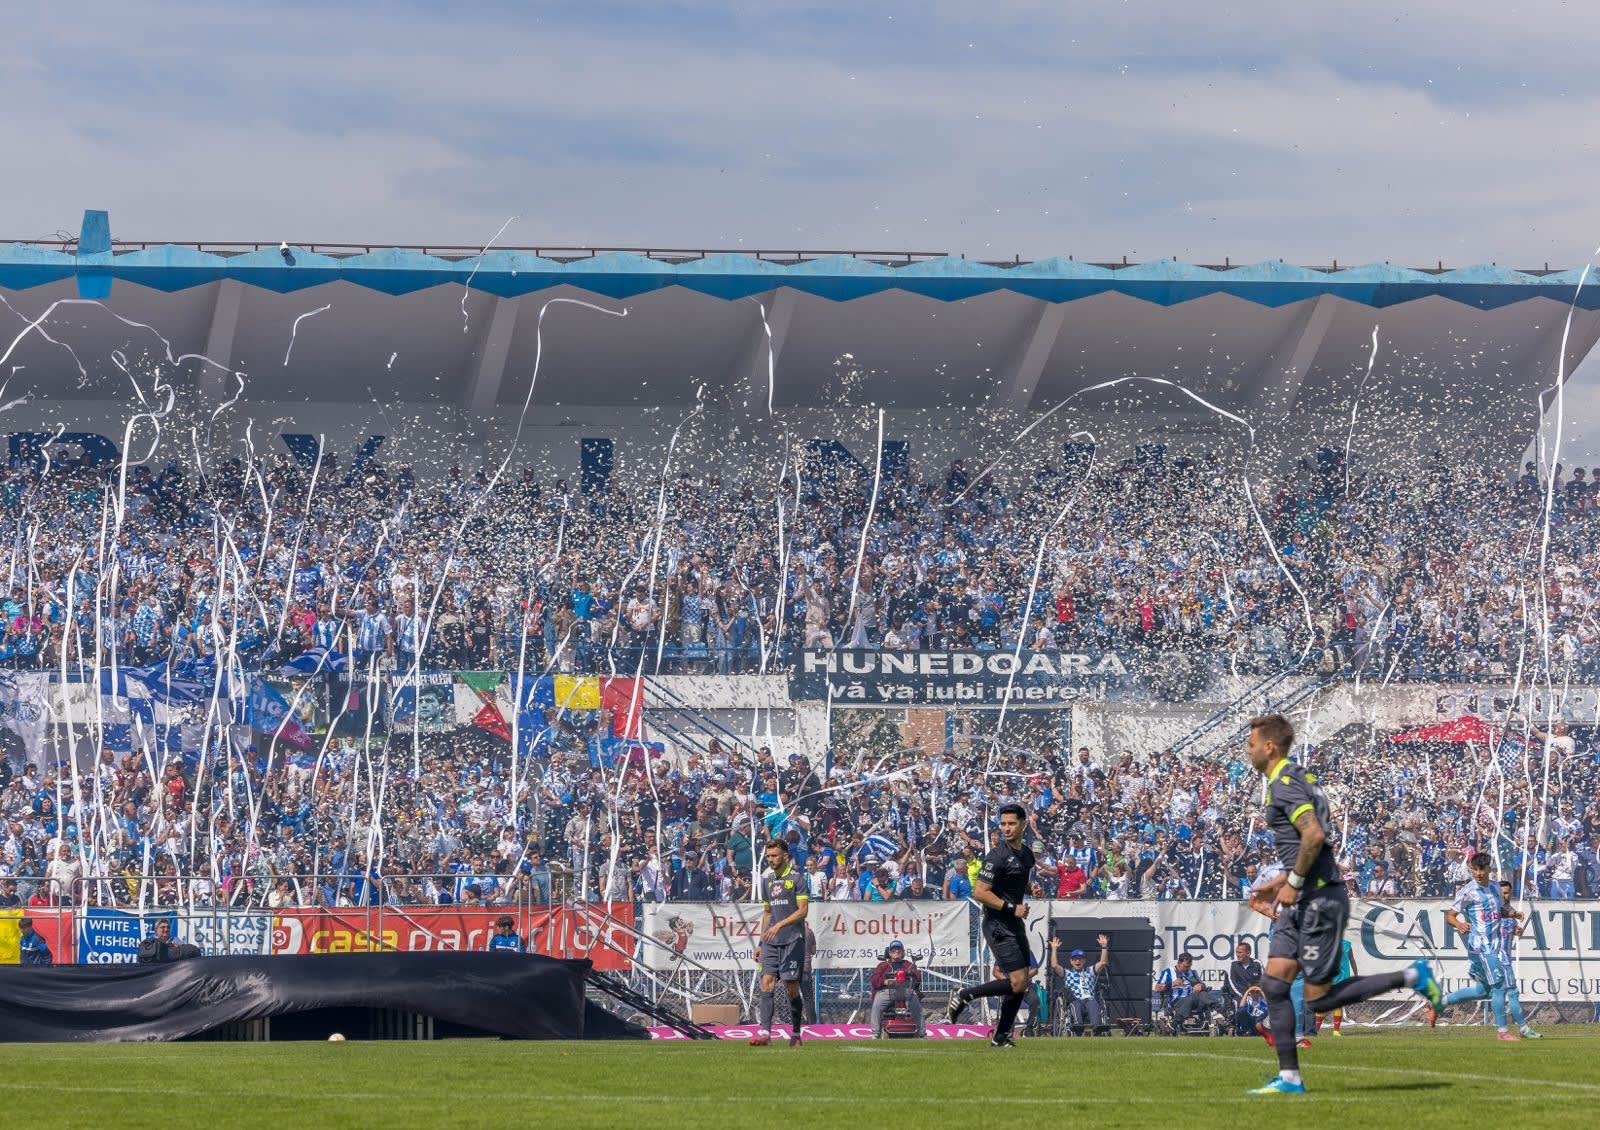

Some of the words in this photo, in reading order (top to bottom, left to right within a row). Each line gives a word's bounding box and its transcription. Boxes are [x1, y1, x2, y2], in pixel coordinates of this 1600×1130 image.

[803, 652, 1127, 675] HUNEDOARA
[831, 681, 866, 698] vă
[926, 682, 984, 698] iubi
[89, 919, 130, 932] WHITE
[194, 916, 268, 931] ULTRAS
[195, 931, 223, 943] OLD
[229, 933, 265, 945] BOYS
[310, 929, 399, 953] casa
[692, 949, 753, 961] www.4colt
[1302, 945, 1320, 960] 25
[1531, 978, 1561, 995] CU
